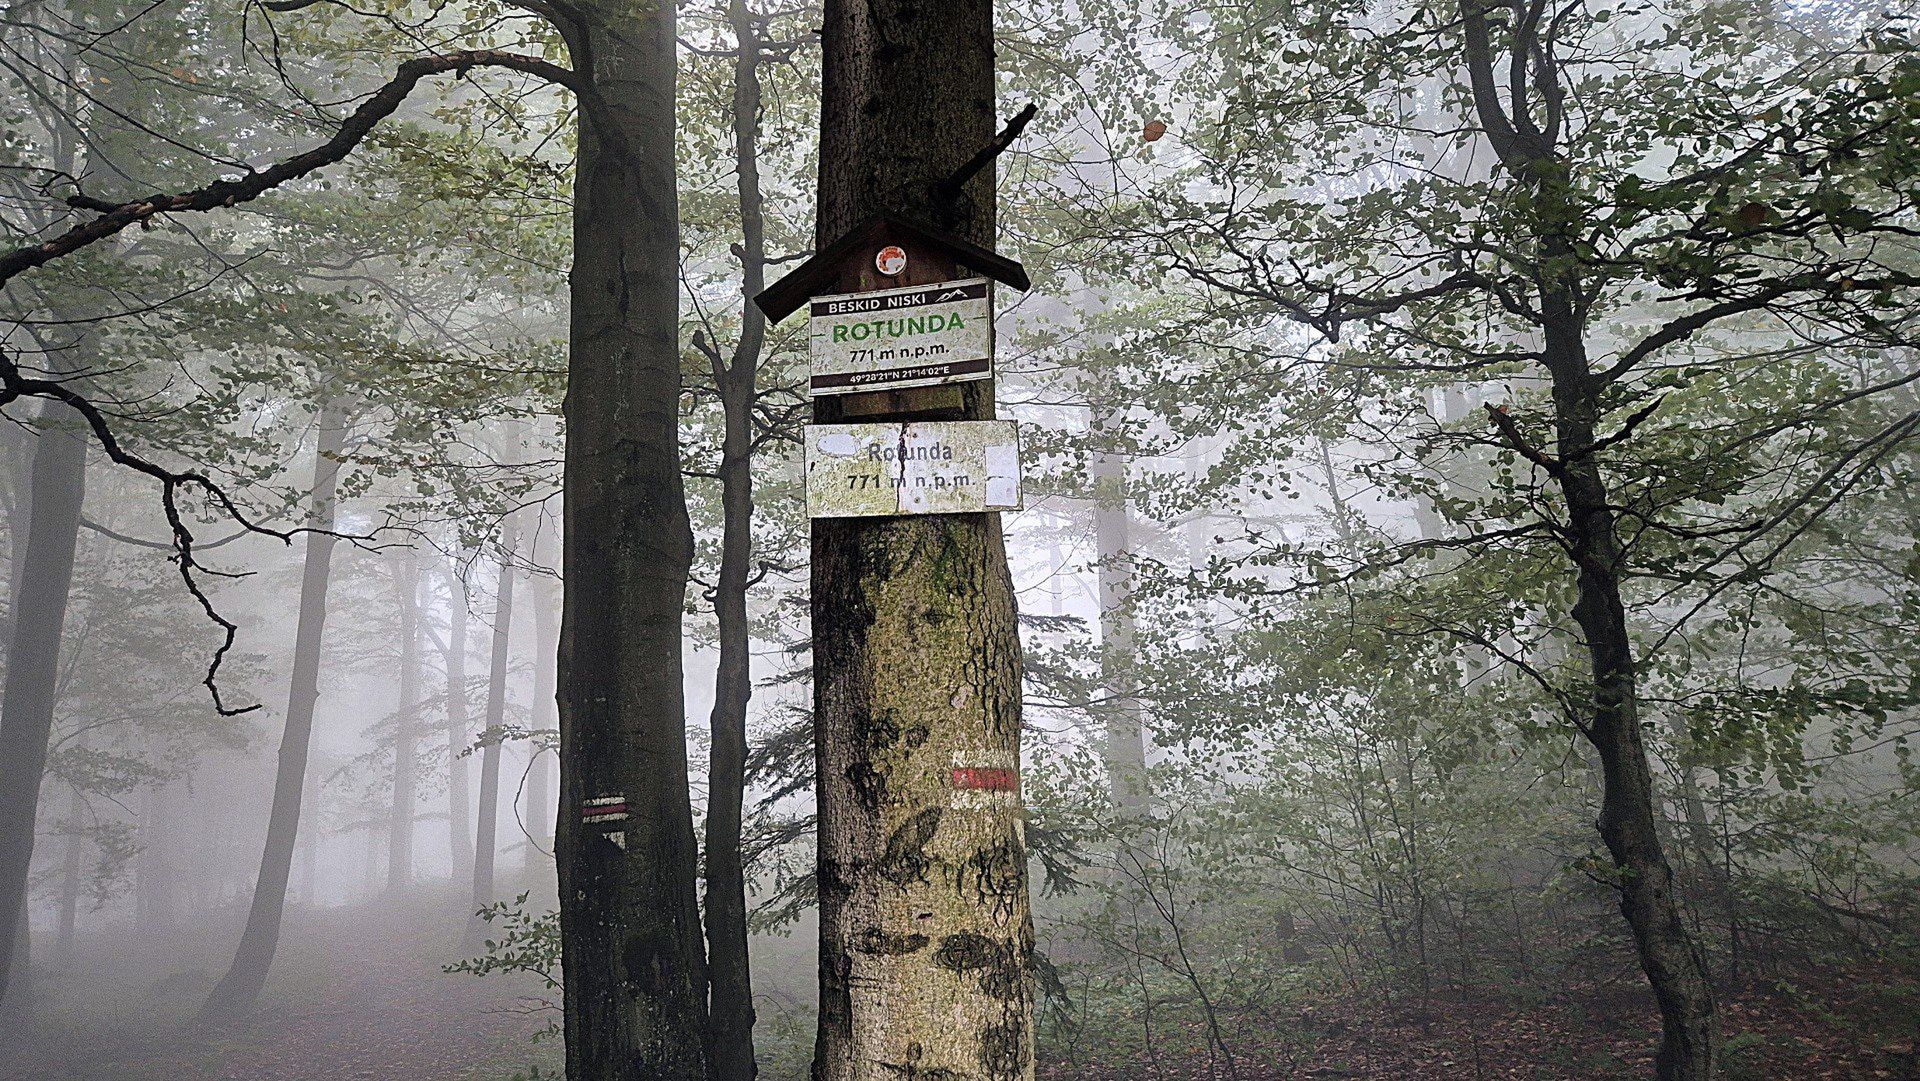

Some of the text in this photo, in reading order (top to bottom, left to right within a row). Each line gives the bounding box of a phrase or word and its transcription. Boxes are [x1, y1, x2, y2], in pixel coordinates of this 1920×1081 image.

[829, 293, 926, 314] BESKID NISKI
[832, 312, 965, 343] ROTUNDA
[850, 344, 950, 362] 771 m n.p.m.
[848, 473, 976, 490] 771 m n.p.m.
